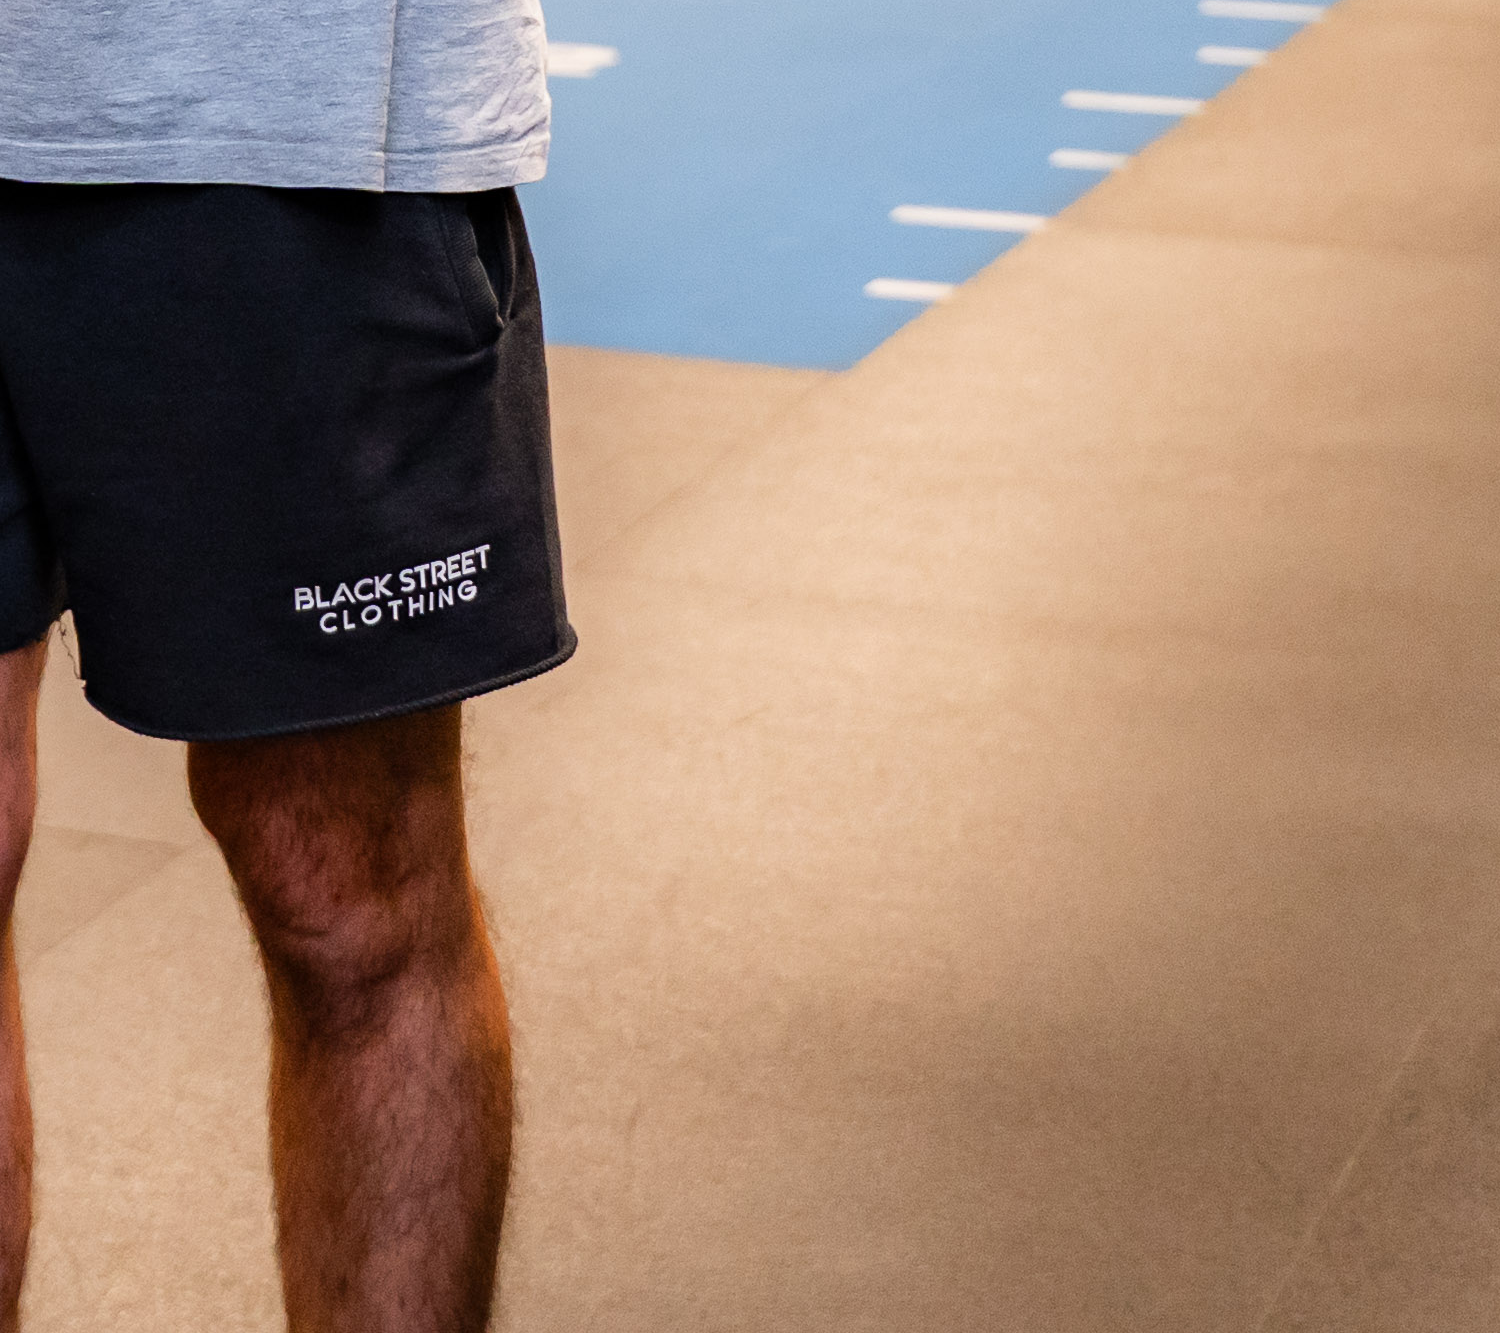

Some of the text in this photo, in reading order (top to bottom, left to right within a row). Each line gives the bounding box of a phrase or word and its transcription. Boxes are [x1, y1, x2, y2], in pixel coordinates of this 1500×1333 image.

[294, 543, 491, 611] BLACK STREET
[319, 579, 478, 634] CLOTHING
